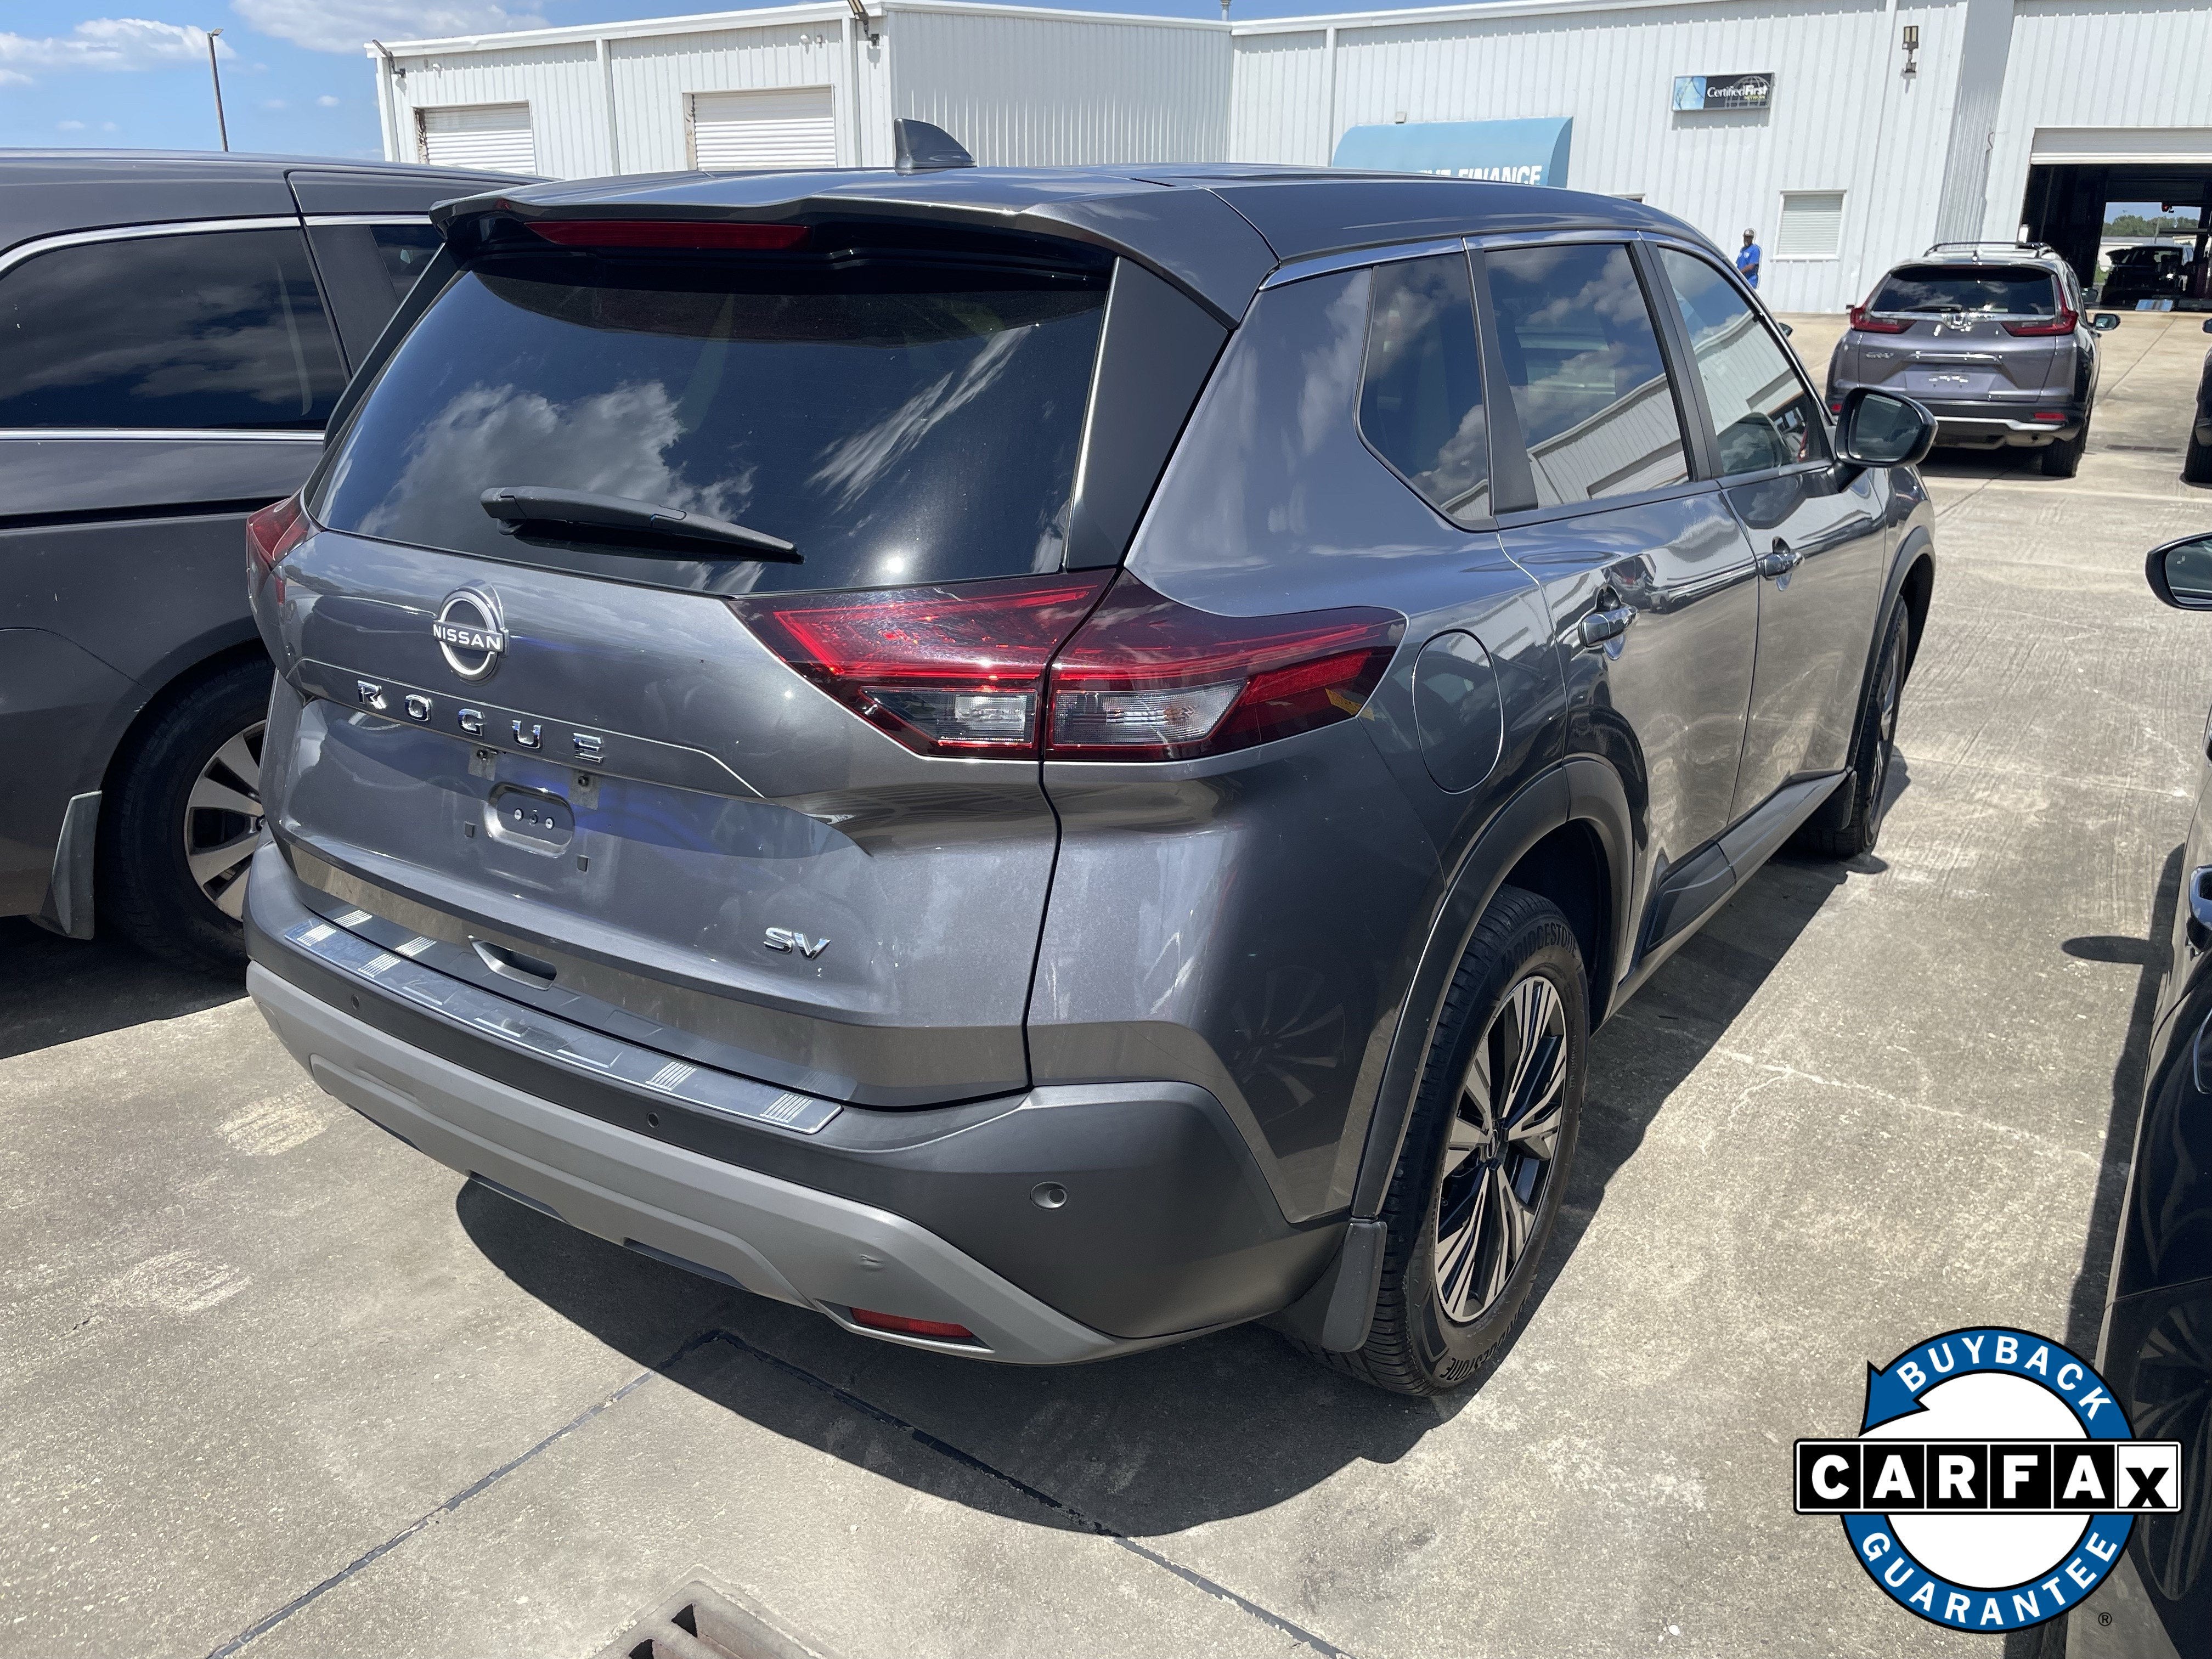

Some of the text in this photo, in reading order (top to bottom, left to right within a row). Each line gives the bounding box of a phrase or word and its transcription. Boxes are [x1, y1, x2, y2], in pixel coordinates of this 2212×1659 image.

[432, 624, 501, 650] NISSAN
[357, 680, 603, 763] ROGUE
[763, 927, 831, 960] SV
[1506, 922, 1577, 978] BRIDGESTONE
